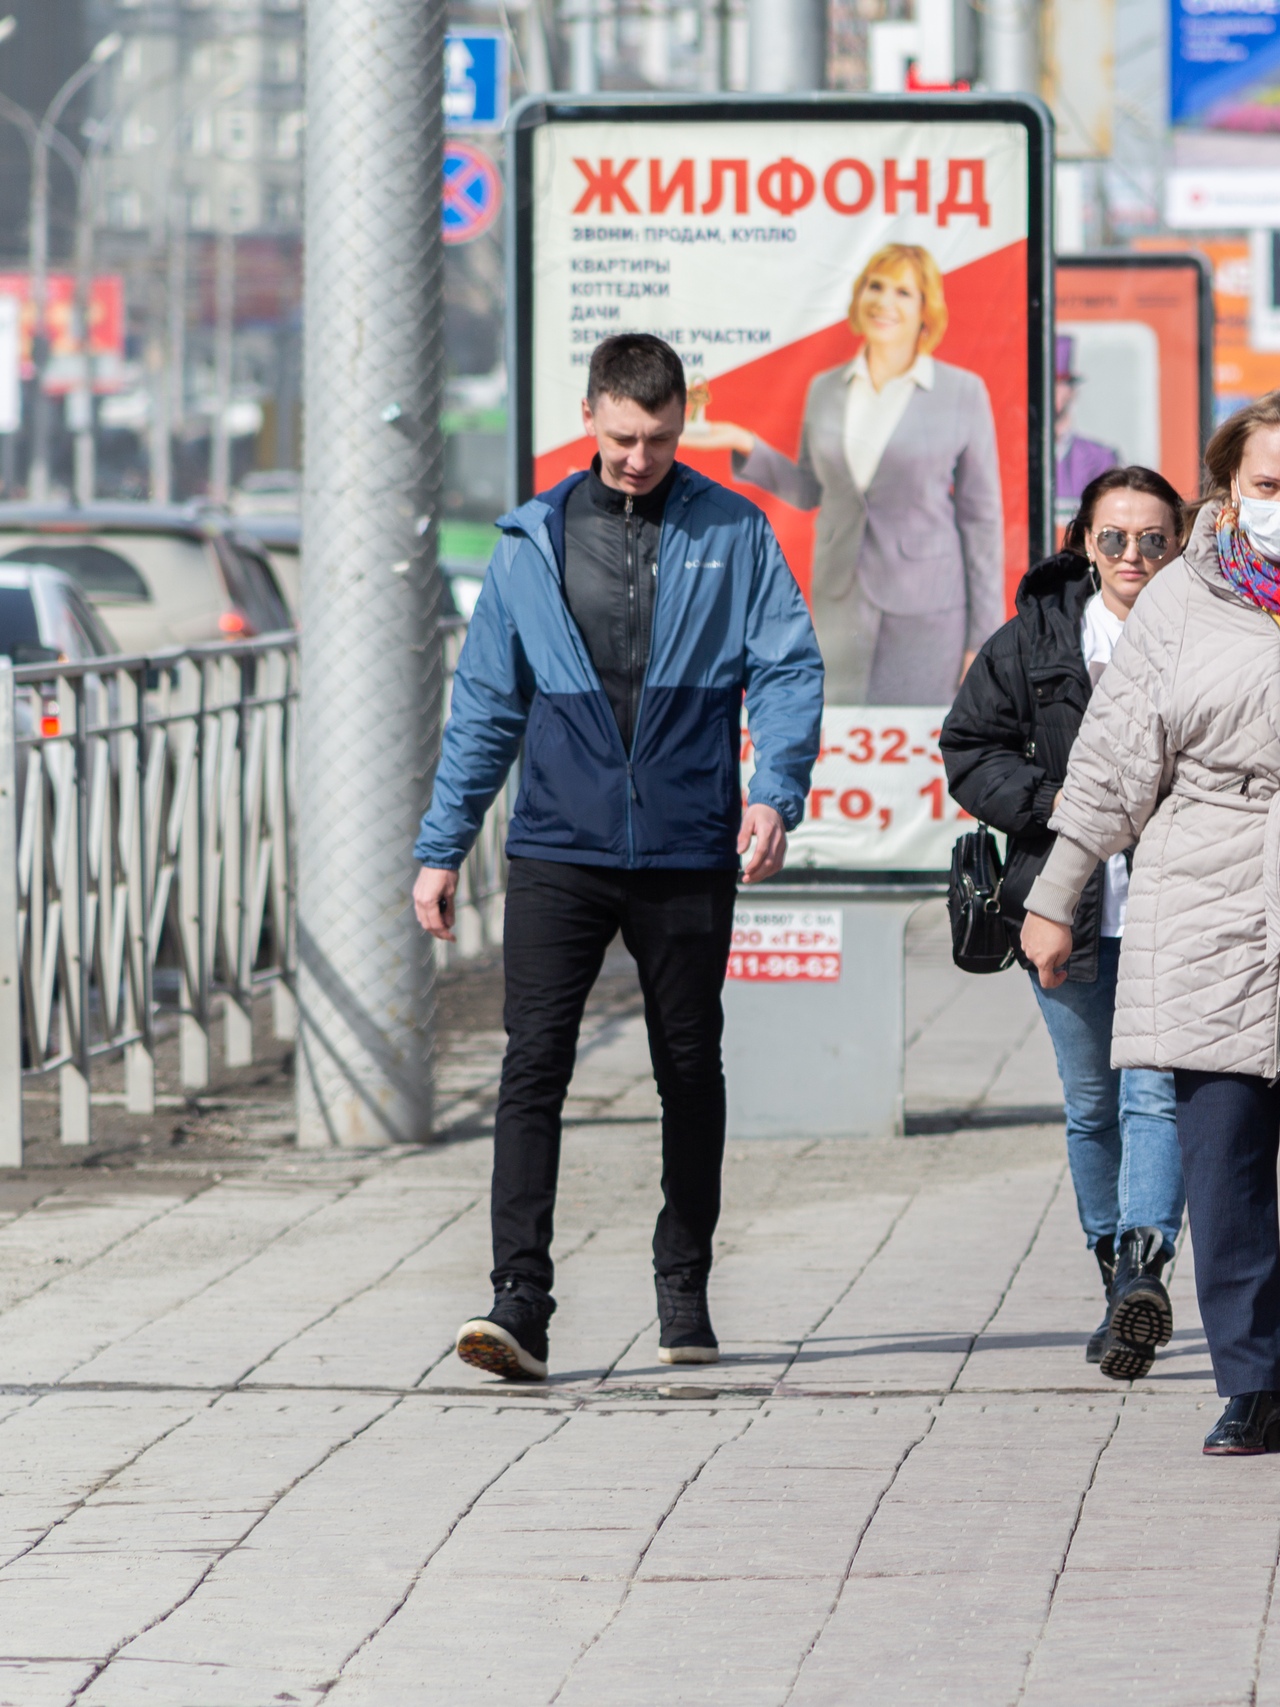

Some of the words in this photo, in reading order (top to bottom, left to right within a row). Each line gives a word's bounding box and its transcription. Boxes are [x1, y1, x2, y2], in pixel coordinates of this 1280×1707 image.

[572, 156, 992, 228] ЖИЛФОНД
[572, 227, 640, 243] ЗВОНИ:
[644, 227, 727, 245] ПРОДАМ,
[731, 227, 797, 243] КУПЛЮ
[571, 258, 671, 274] КВАРТИРЫ
[571, 281, 670, 297] КОТТЕДЖИ
[571, 305, 620, 321] ДАЧИ
[689, 328, 771, 345] УЧАСТКИ
[728, 954, 839, 978] 11-96-62
